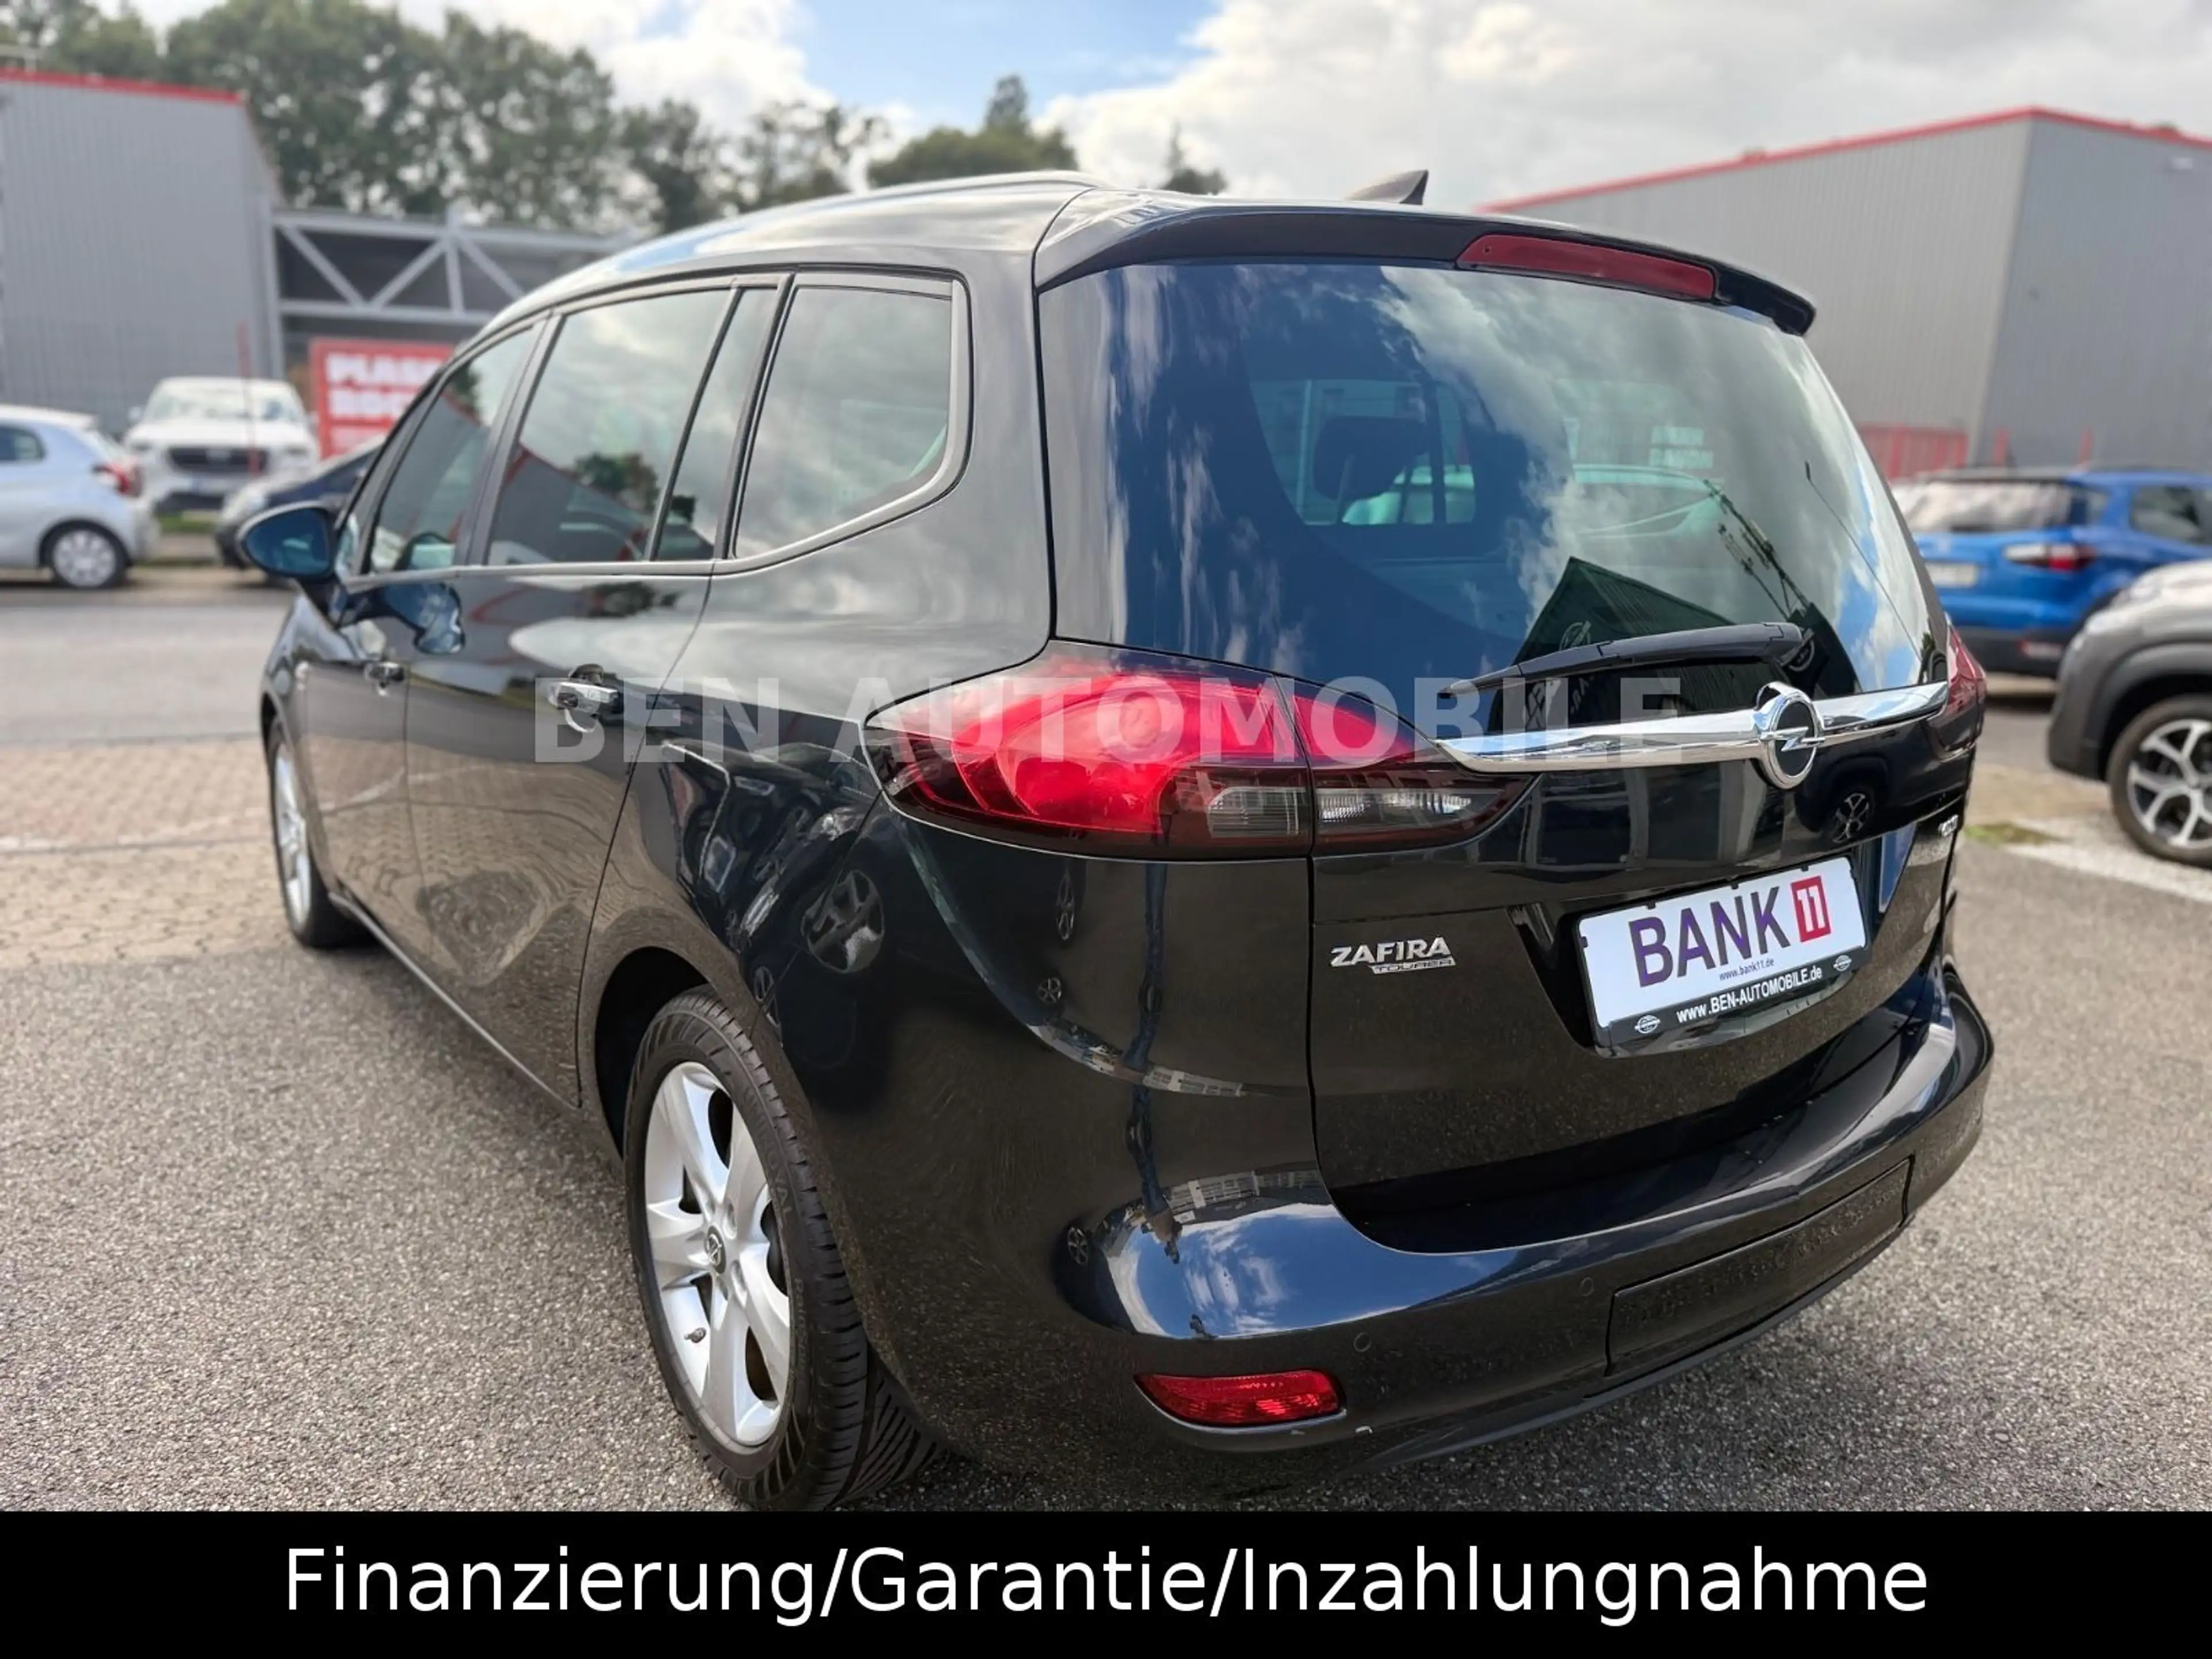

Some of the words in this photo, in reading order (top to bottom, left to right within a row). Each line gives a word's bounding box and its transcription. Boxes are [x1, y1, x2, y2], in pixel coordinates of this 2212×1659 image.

[1628, 887, 1791, 987] BANK
[1796, 885, 1826, 933] 11
[1330, 937, 1451, 967] ZAFIRA
[1718, 957, 1774, 980] www.bank11.de
